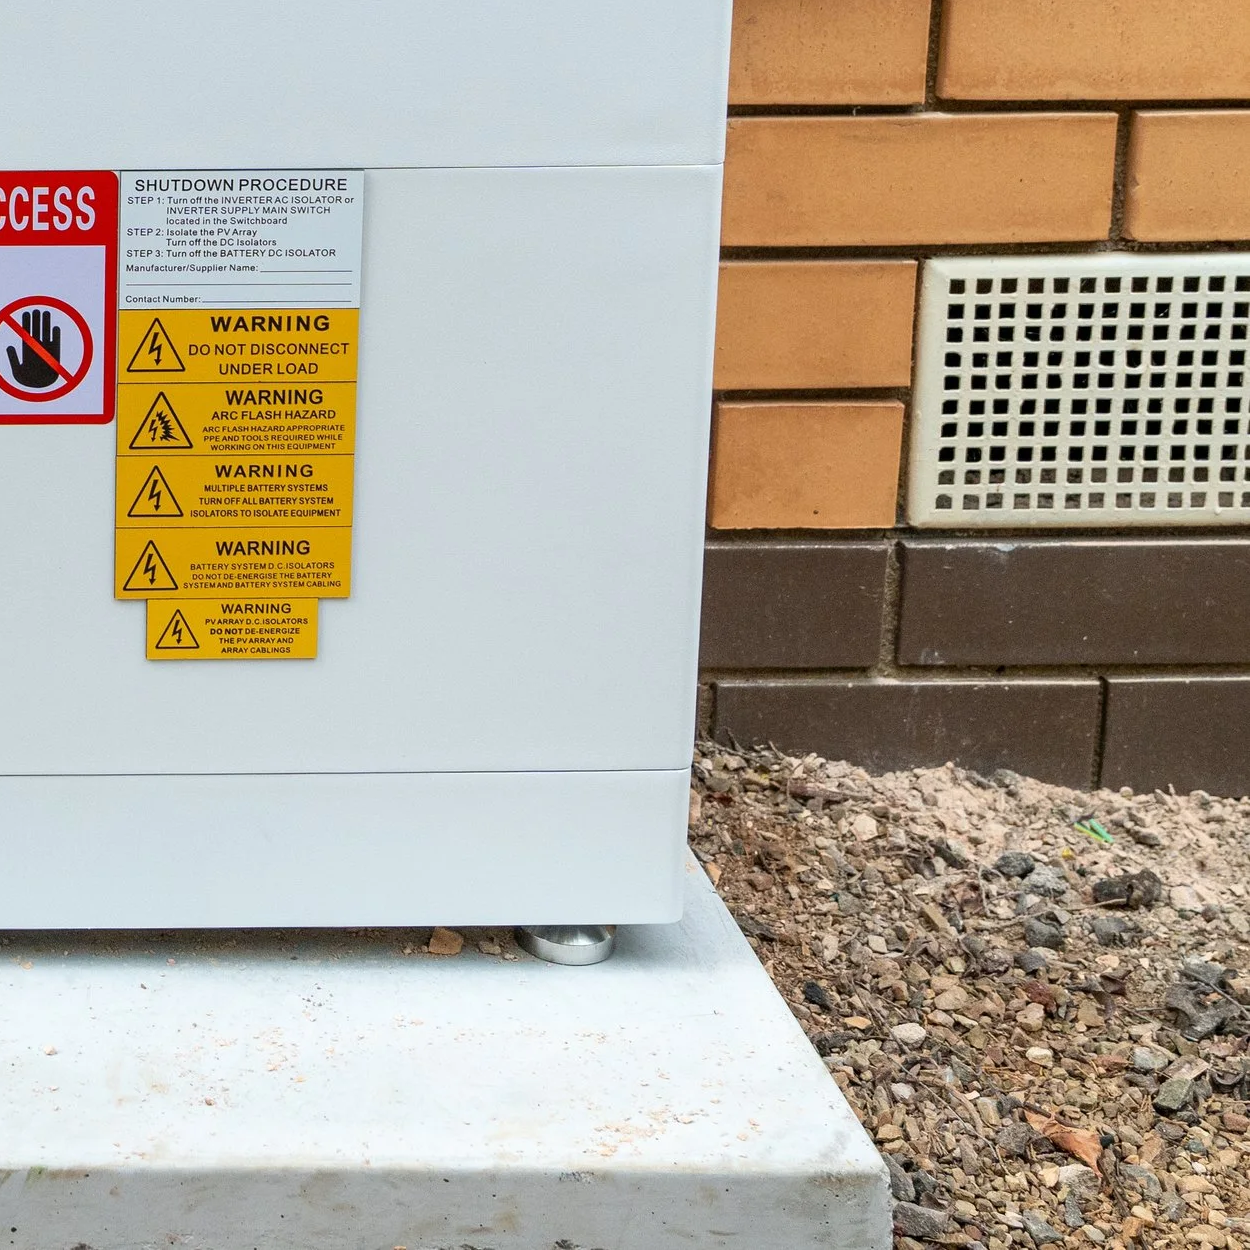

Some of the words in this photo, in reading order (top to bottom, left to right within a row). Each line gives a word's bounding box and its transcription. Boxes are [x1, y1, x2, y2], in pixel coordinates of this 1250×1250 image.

[135, 179, 233, 191] SHUTDOWN
[240, 179, 347, 191] PROCEDURE
[222, 196, 275, 204] INVERTER
[275, 196, 288, 204] AC
[291, 196, 342, 204] ISOLATOR
[263, 206, 287, 214] MAIN
[290, 206, 330, 214] SWITCH
[203, 217, 210, 225] in
[214, 217, 227, 225] the
[127, 228, 153, 236] STEP
[200, 228, 214, 236] the
[232, 229, 257, 237] Array
[220, 238, 234, 246] DC
[203, 250, 217, 258] the
[268, 249, 282, 257] DC
[285, 249, 335, 257] ISOLATOR
[126, 264, 226, 273] Manufacturer/Supplier
[230, 264, 258, 272] Name:
[163, 295, 201, 303] Number:
[211, 315, 329, 332] WARNING
[189, 344, 210, 355] DO
[215, 344, 246, 355] NOT
[251, 343, 349, 355] DISCONNECT
[220, 363, 272, 375] UNDER
[277, 363, 318, 374] LOAD
[226, 389, 322, 405] WARNING
[212, 411, 237, 420] ARC
[242, 411, 281, 420] FLASH
[285, 410, 335, 419] HAZARD
[203, 425, 220, 433] ARC
[222, 425, 249, 433] FLASH
[251, 425, 285, 433] HAZARD
[286, 424, 345, 432] APPROPRIATE
[204, 435, 220, 443] PPE
[242, 434, 269, 442] TOOLS
[317, 433, 342, 441] WHILE
[211, 443, 250, 451] WORKING
[253, 443, 264, 451] ON
[215, 465, 313, 477] WARNING
[248, 484, 286, 492] BATTERY
[224, 497, 240, 505] OFF
[259, 497, 297, 505] BATTERY
[291, 509, 341, 517] EQUIPMENT
[216, 540, 310, 556] WARNING
[190, 563, 229, 571] BATTERY
[192, 573, 204, 581] DO
[206, 573, 221, 581] NOT
[280, 572, 294, 580] THE
[221, 603, 291, 614] WARNING
[225, 627, 243, 635] NOT
[245, 627, 300, 635] DE-ENERGIZE
[219, 637, 234, 645] THE
[277, 636, 293, 644] AND
[221, 646, 248, 654] ARRAY
[250, 646, 290, 654] CABLINGS
